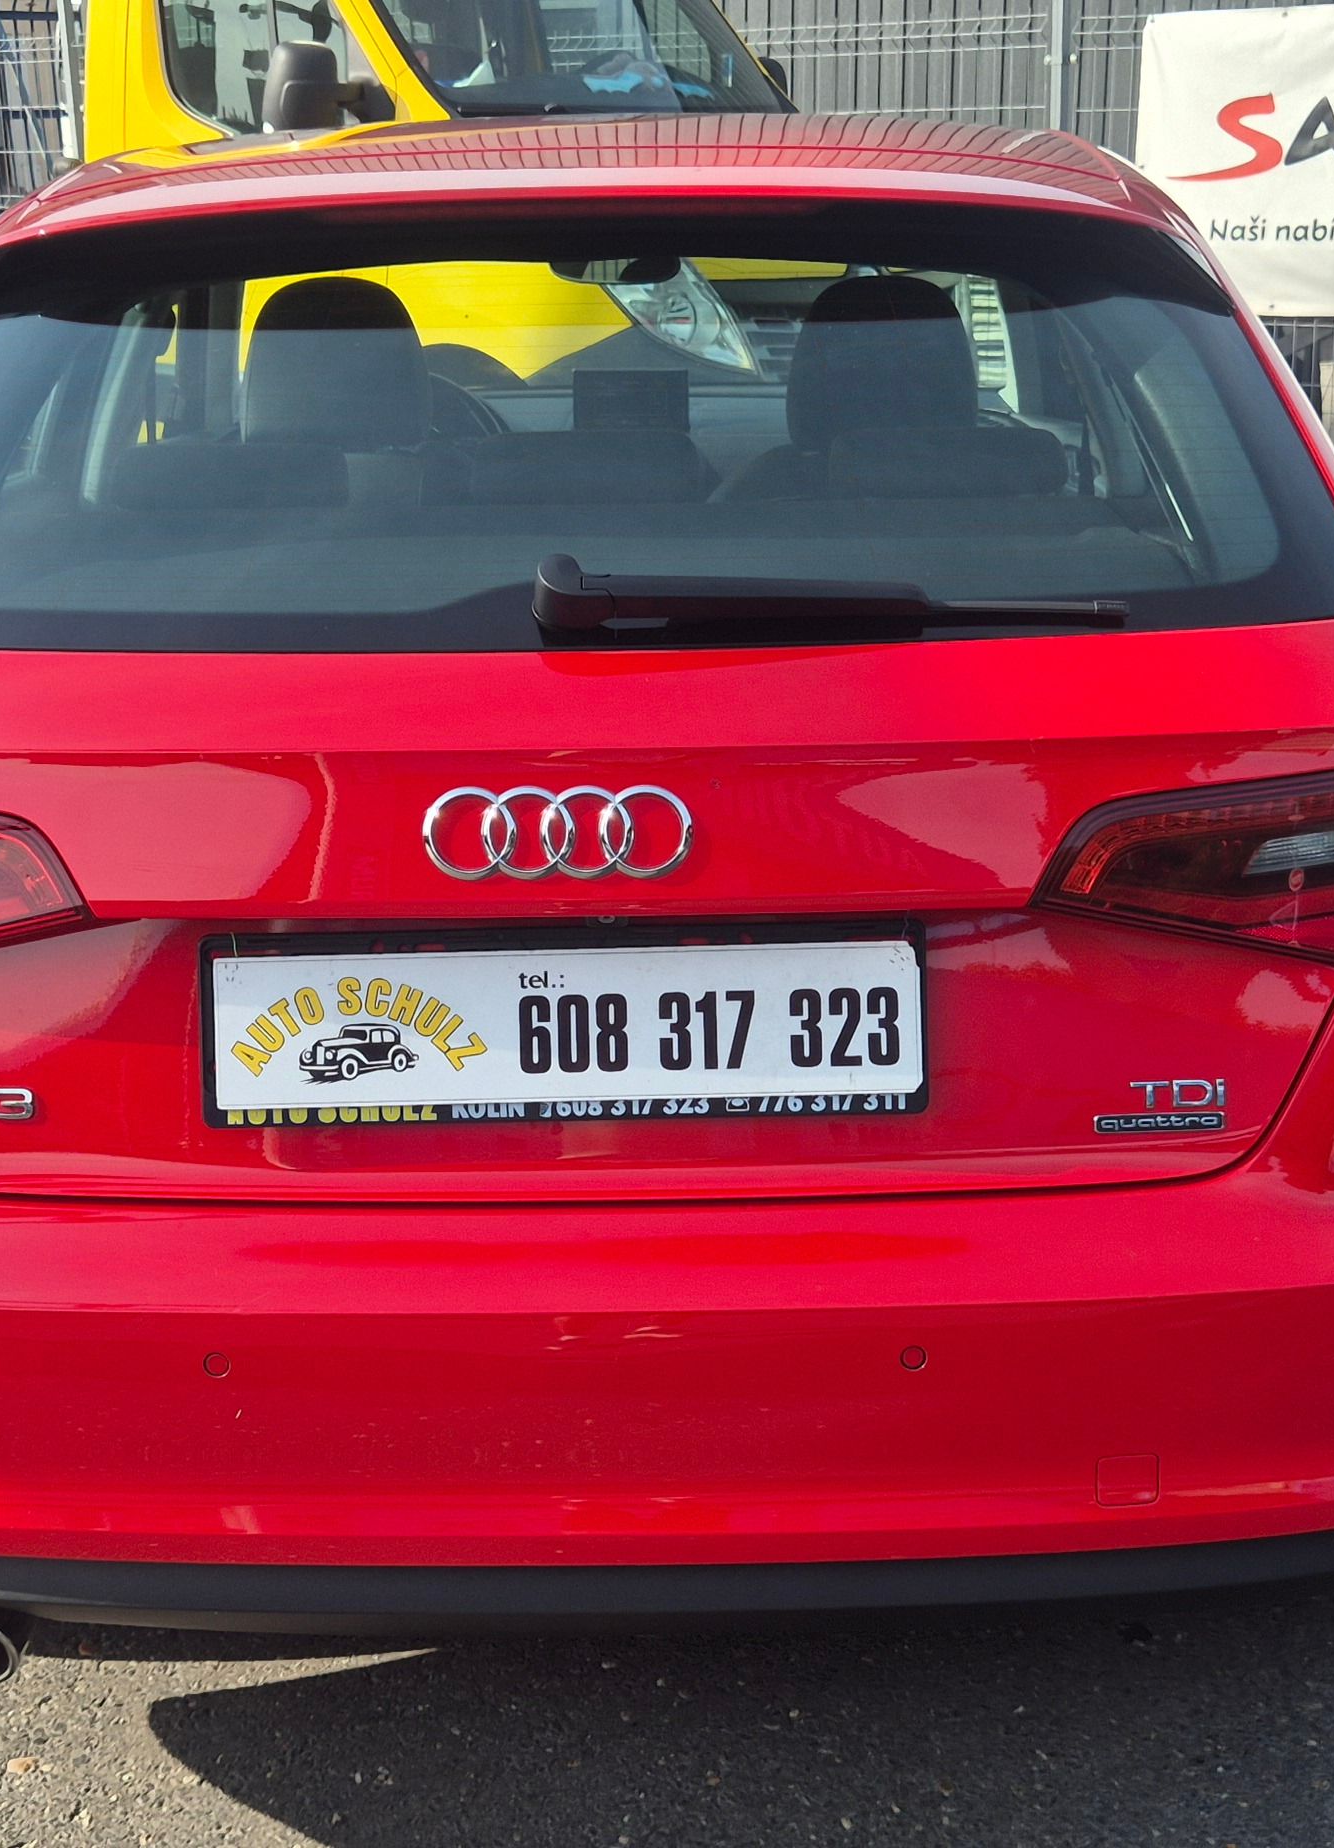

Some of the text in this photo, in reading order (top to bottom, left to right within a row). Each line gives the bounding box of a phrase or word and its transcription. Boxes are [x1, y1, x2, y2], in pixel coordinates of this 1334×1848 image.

[1210, 216, 1265, 241] Naši
[519, 970, 565, 989] tel.:
[230, 976, 488, 1077] AUTO SCHULZ
[518, 986, 900, 1074] 608 317 323
[1100, 1115, 1218, 1131] quattro
